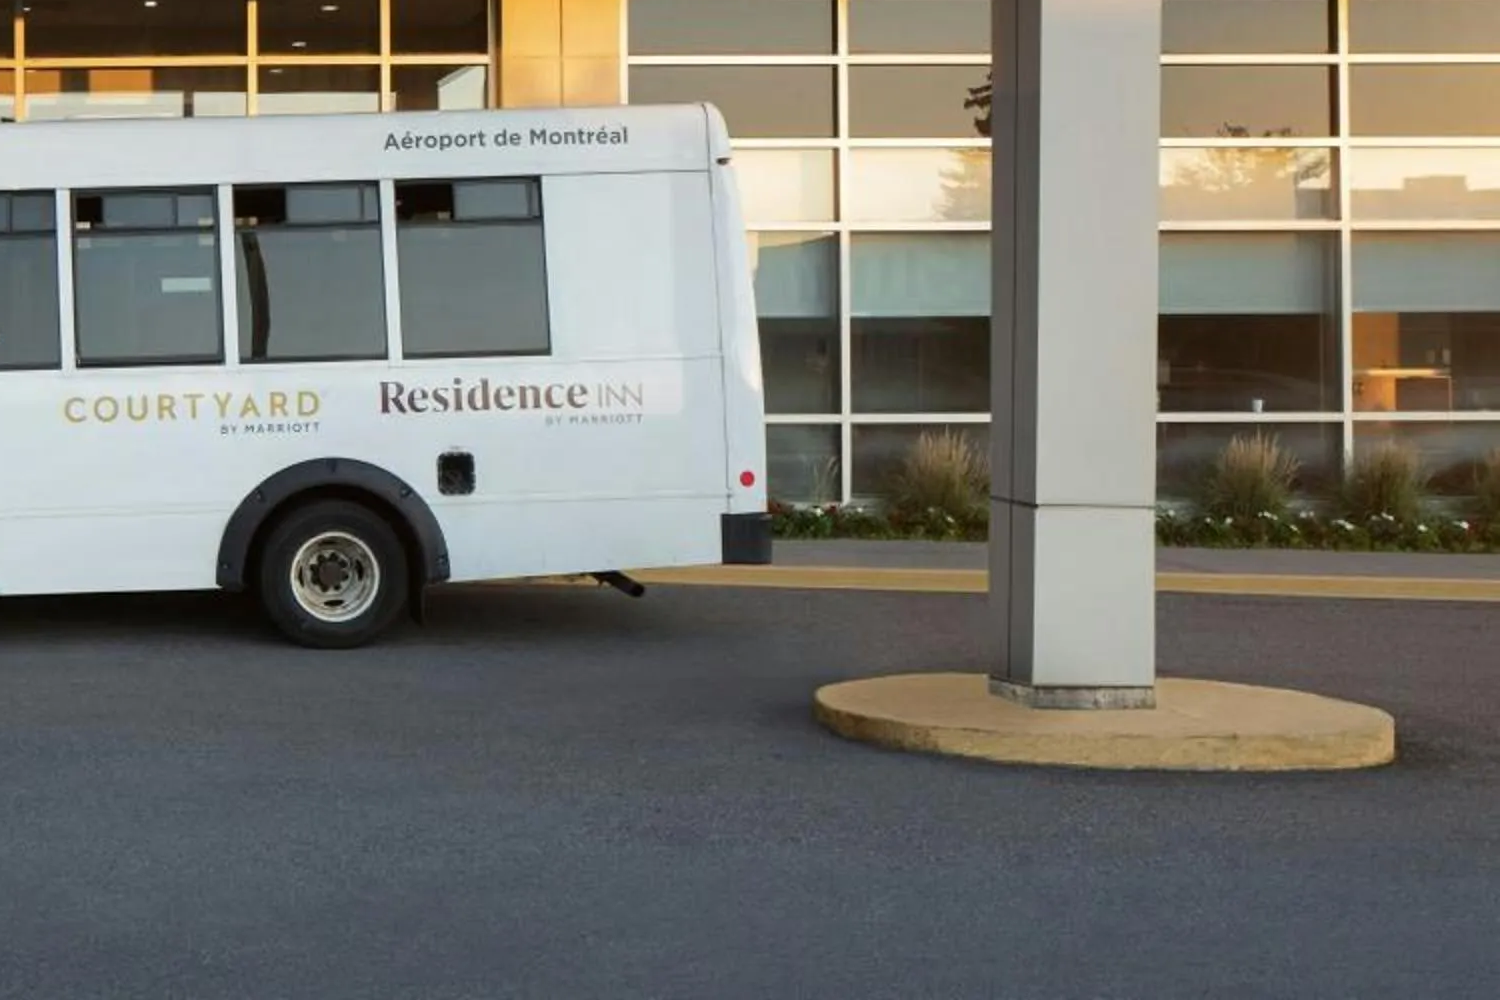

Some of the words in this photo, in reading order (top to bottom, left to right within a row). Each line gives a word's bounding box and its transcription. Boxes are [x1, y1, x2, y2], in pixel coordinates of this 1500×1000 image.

[384, 130, 486, 151] Aéroport
[494, 129, 522, 147] de
[529, 126, 629, 146] Montréal
[63, 391, 320, 423] COURTYARD
[379, 377, 589, 415] Residence
[597, 382, 644, 409] INN
[220, 424, 238, 435] BY
[244, 421, 320, 434] MARRIOTT
[545, 416, 562, 427] BY
[568, 413, 644, 426] MARRIOTT
